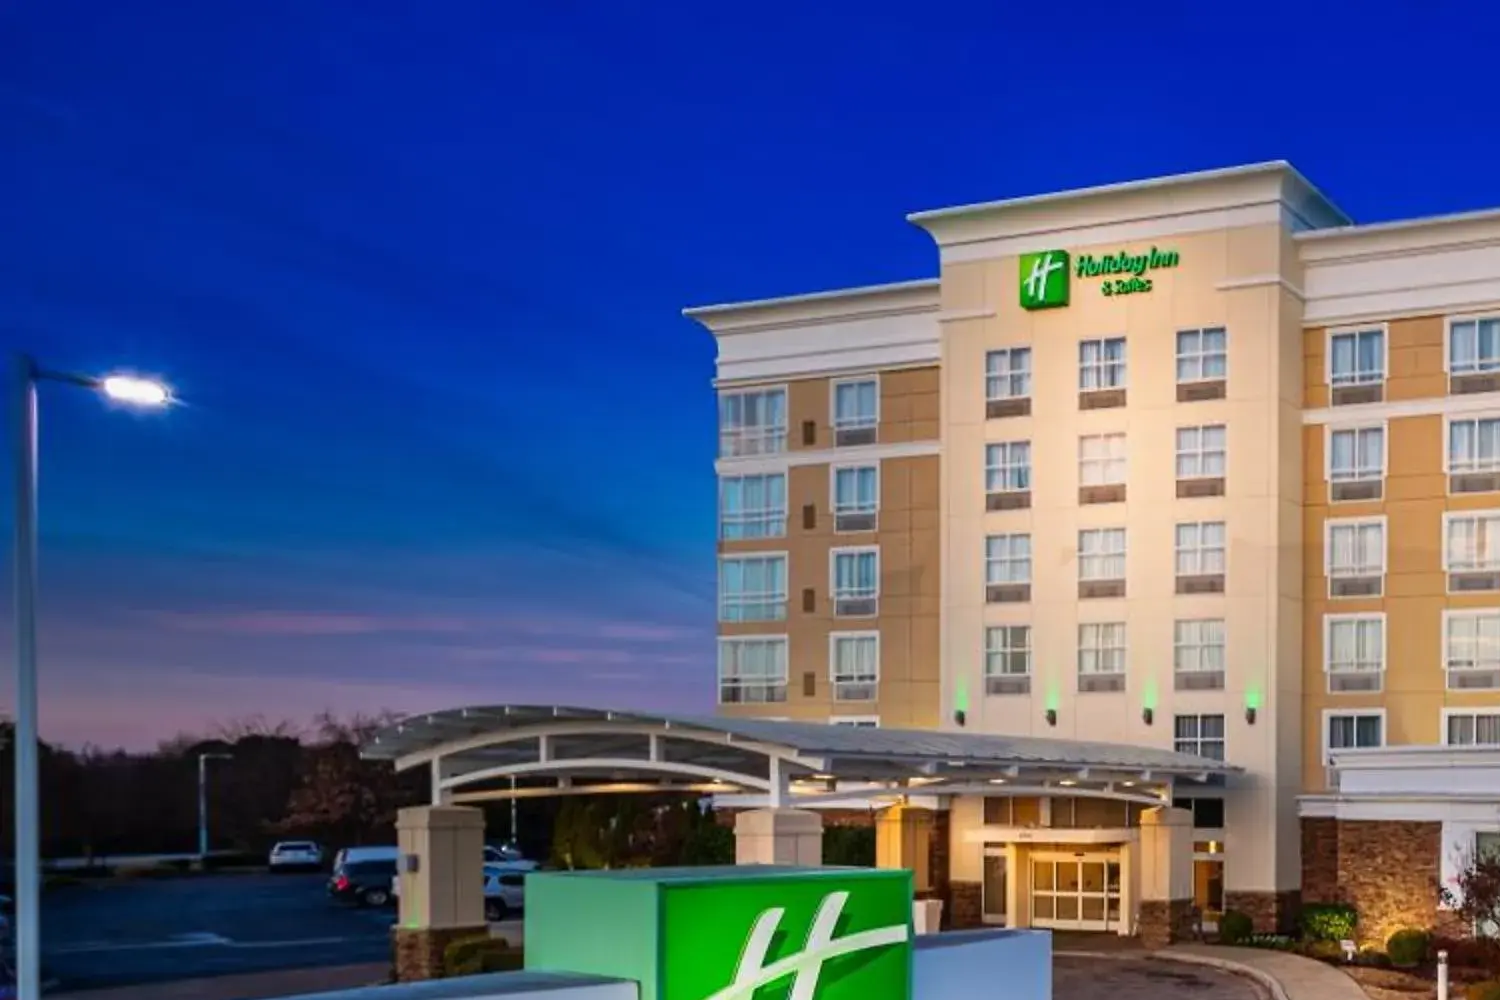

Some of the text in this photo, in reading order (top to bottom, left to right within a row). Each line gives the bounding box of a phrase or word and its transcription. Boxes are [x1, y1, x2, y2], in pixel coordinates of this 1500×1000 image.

[1077, 247, 1179, 277] Holiday Inn
[1101, 278, 1152, 297] & Suites
